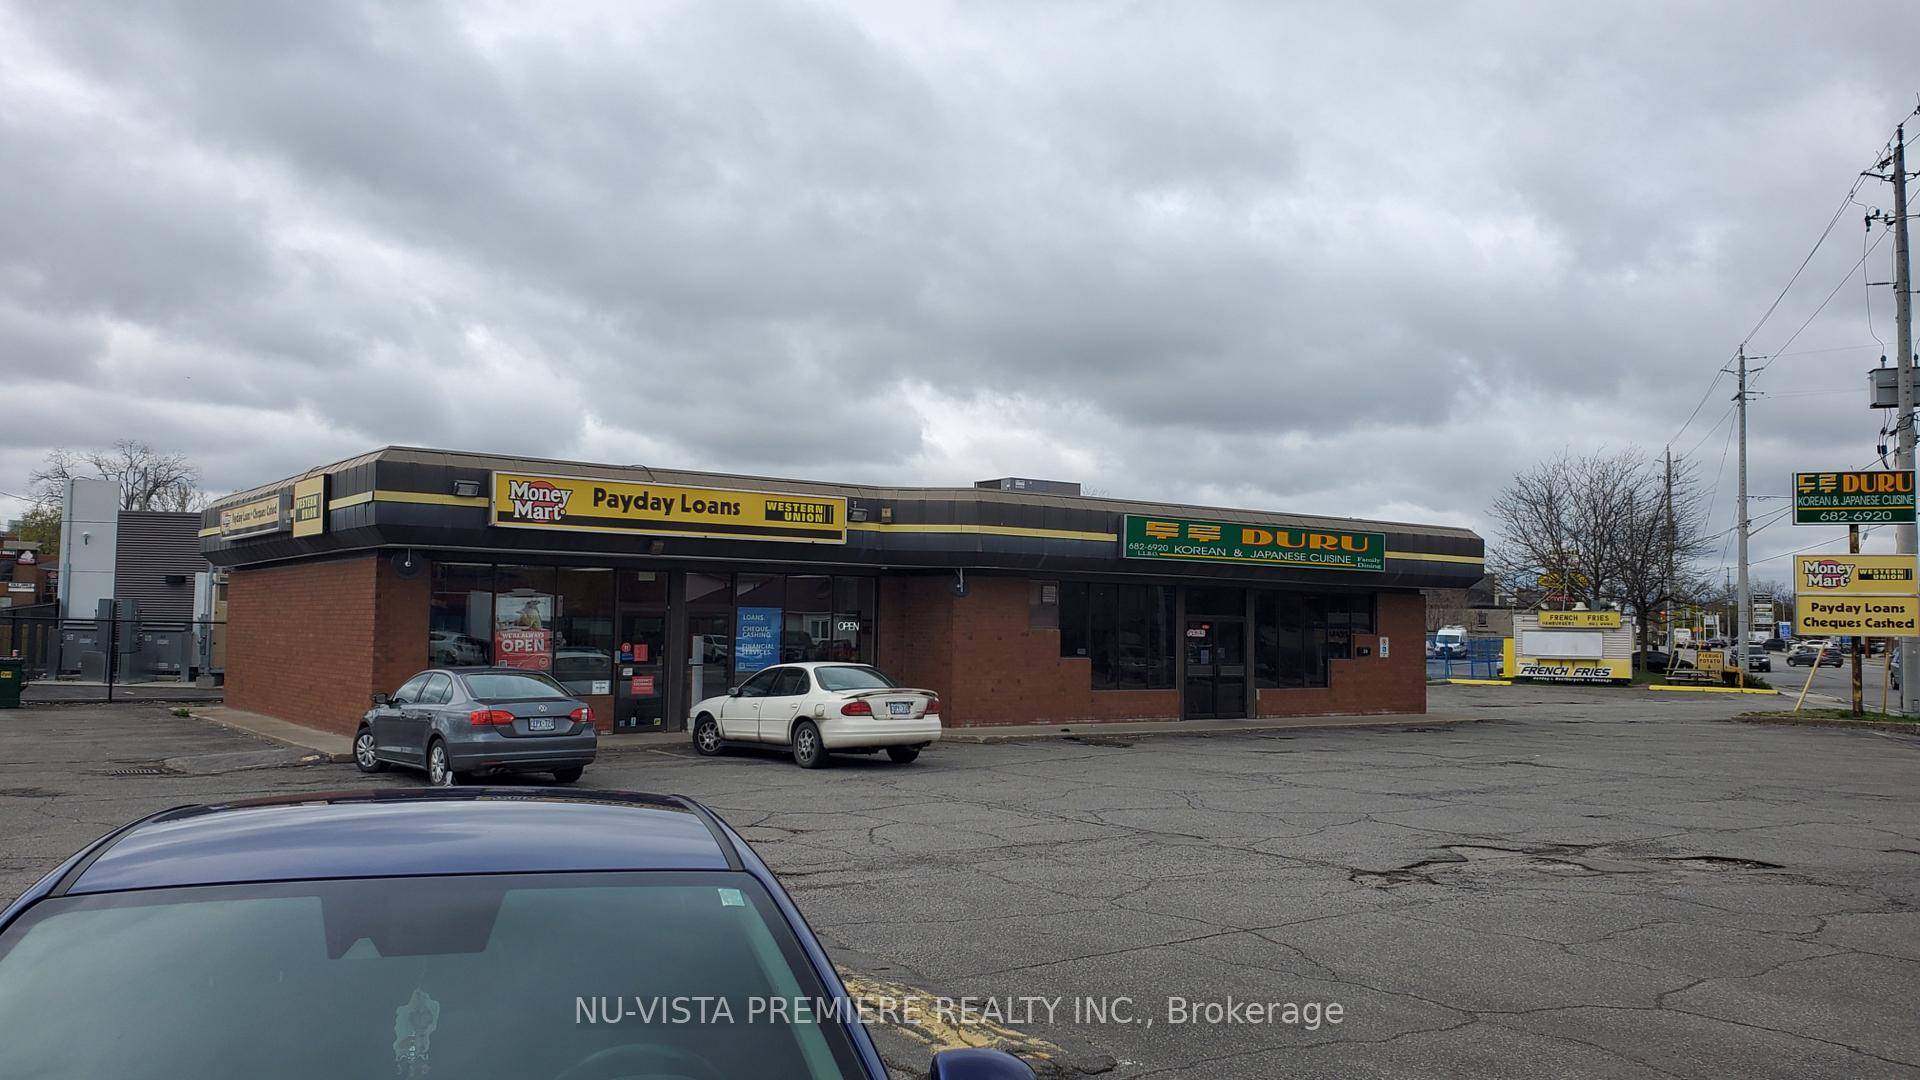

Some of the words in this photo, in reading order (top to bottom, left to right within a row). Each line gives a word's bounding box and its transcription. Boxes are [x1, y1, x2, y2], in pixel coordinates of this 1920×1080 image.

[1843, 472, 1913, 493] DURU
[509, 481, 572, 508] Money
[1798, 496, 1831, 506] KOREAN
[1832, 496, 1839, 505] &
[1840, 495, 1880, 506] JAPANESE
[1882, 495, 1914, 505] CUISINE
[593, 487, 675, 516] Payday
[681, 494, 741, 516] Loans
[766, 501, 823, 514] WESTERN
[513, 500, 563, 520] Mart
[1820, 511, 1892, 521] 682-6920
[784, 512, 823, 523] UNION
[1242, 527, 1368, 552] DURU
[1128, 542, 1169, 552] 682-6920
[1174, 545, 1226, 556] KOREAN
[1233, 548, 1243, 557] &
[1250, 550, 1306, 561] JAPANESE
[1309, 553, 1352, 564] CUISINE
[1357, 556, 1381, 564] Family
[1357, 562, 1381, 570] Dining
[1804, 561, 1855, 577] Money
[1811, 603, 1861, 613] Payday
[1865, 603, 1905, 613] Loans
[838, 621, 859, 631] OPEN
[1803, 617, 1861, 629] Cheques
[1865, 618, 1914, 629] Cashed
[502, 639, 544, 652] OPEN
[1521, 666, 1569, 676] FRENCH
[1573, 667, 1612, 677] FRIES
